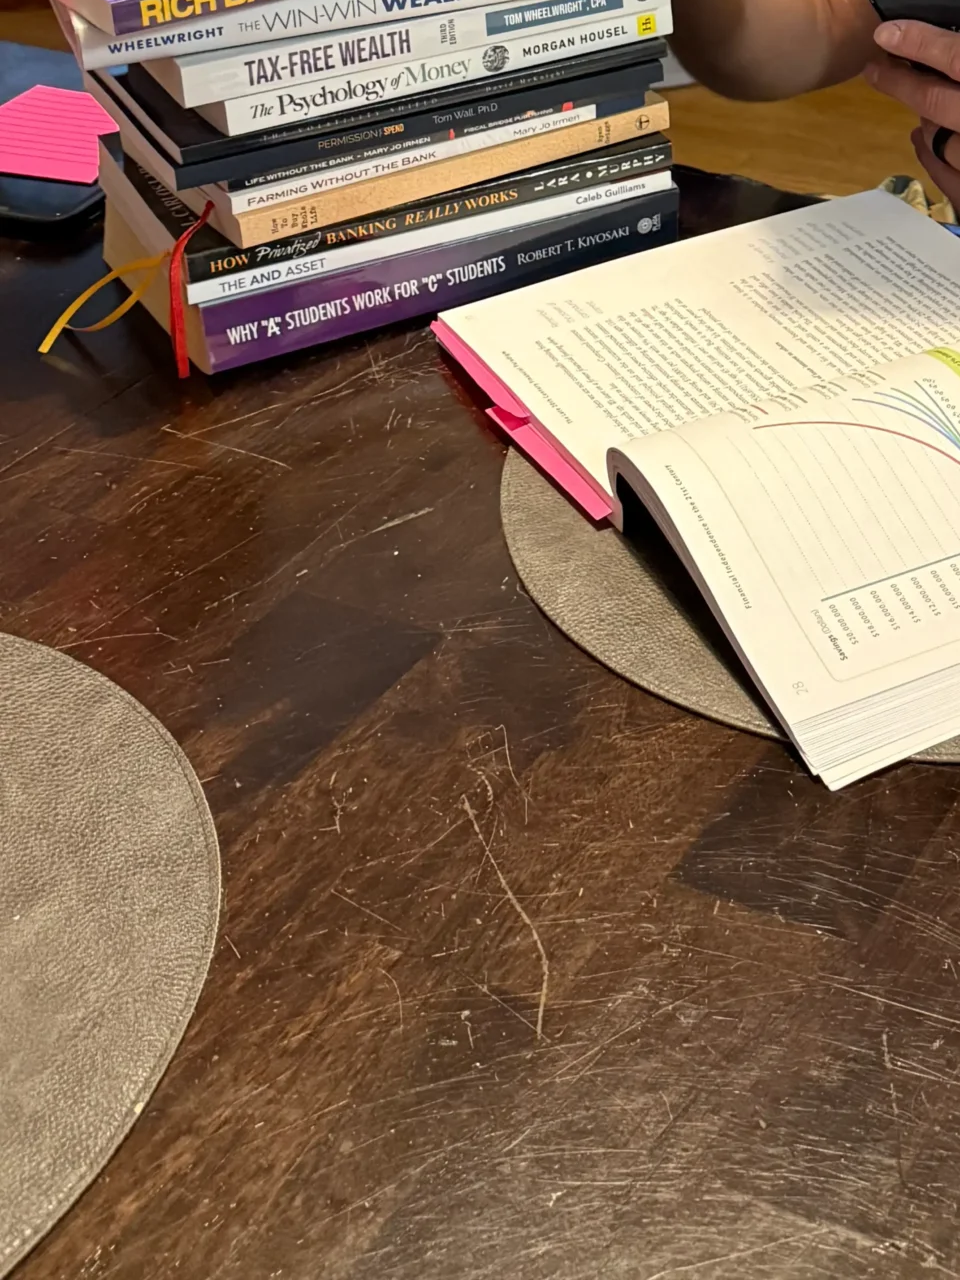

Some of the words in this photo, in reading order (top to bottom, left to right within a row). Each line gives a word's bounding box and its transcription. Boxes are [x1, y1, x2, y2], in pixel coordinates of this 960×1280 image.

[108, 25, 224, 54] WHEELWRIGHT
[238, 19, 260, 33] THE
[449, 18, 457, 45] EDITION
[504, 7, 523, 26] TOM
[244, 44, 336, 86] TAX-FREE
[338, 29, 412, 66] WEALTH
[250, 104, 273, 120] The
[277, 75, 388, 117] Psychology
[390, 74, 404, 91] of
[404, 58, 472, 87] Money
[523, 37, 576, 57] MORGAN
[580, 25, 628, 45] HOUSEL
[318, 129, 379, 150] PERMISSION
[383, 124, 405, 136] SPEND
[432, 111, 453, 125] Tom
[245, 177, 266, 187] LIFE
[267, 166, 307, 182] WITHOUT
[309, 161, 328, 172] THE
[329, 154, 354, 167] BANK
[363, 146, 389, 158] MARY
[389, 142, 402, 152] JO
[402, 136, 431, 149] IRMEN
[464, 123, 487, 133] FISCAL
[247, 180, 307, 207] FARMING
[311, 168, 370, 190] WITHOUT
[373, 161, 399, 175] THE
[401, 151, 437, 167] BANK
[513, 125, 538, 138] Mary
[539, 121, 550, 132] Jo
[552, 114, 580, 128] Irmen
[209, 253, 250, 273] HOW
[255, 231, 322, 263] Privatized
[325, 217, 397, 245] BANKING
[404, 200, 464, 226] REALLY
[464, 188, 519, 210] WORKS
[219, 278, 246, 294] THE
[250, 269, 281, 286] AND
[285, 258, 327, 277] ASSET
[575, 192, 602, 205] Caleb
[604, 182, 647, 199] Guilliams
[226, 321, 258, 346] WHY
[261, 317, 281, 337] "A"
[285, 297, 351, 330] STUDENTS
[352, 288, 392, 311] WORK
[393, 281, 419, 301] FOR
[421, 272, 443, 293] "C"
[447, 256, 506, 286] STUDENTS
[517, 243, 562, 265] ROBERT
[564, 239, 575, 252] T.
[578, 226, 630, 249] KIYOSAKI
[680, 486, 691, 500] 21st
[689, 502, 699, 512] the
[702, 523, 732, 573] Independence
[727, 572, 753, 610] Financial
[828, 634, 847, 660] Savings
